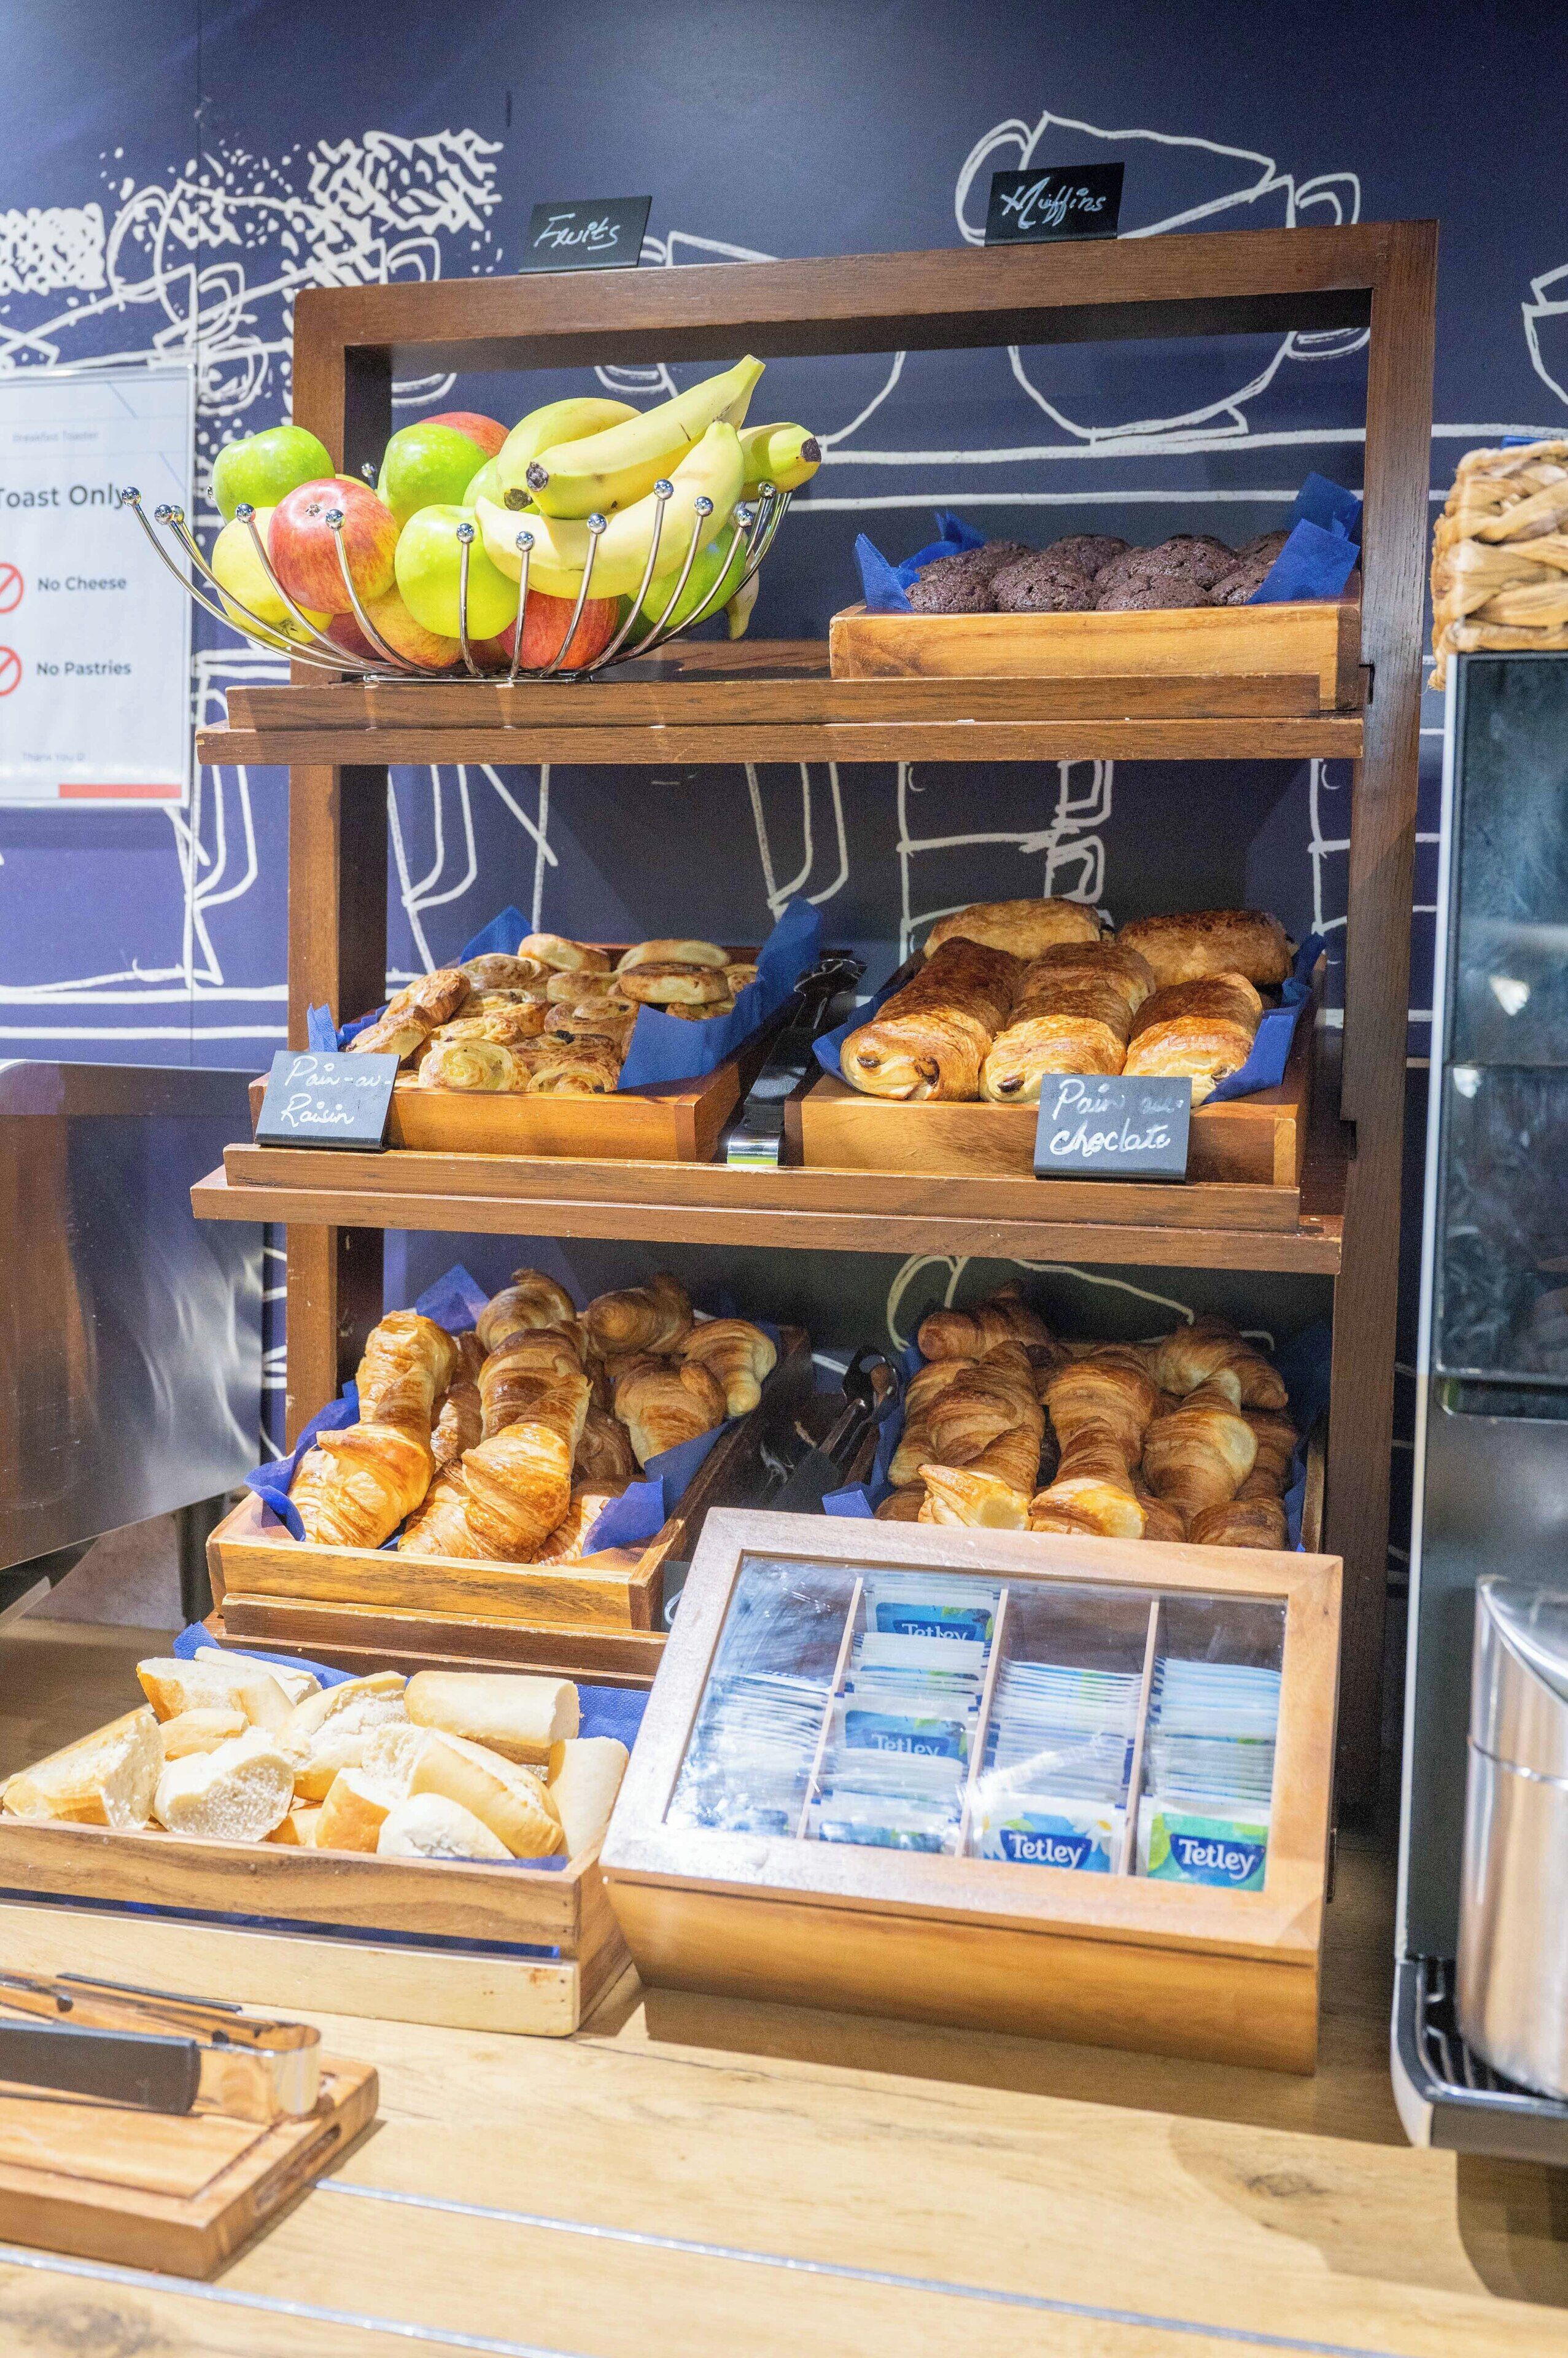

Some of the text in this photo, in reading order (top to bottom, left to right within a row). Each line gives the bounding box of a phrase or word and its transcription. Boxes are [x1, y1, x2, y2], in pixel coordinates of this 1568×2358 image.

[999, 176, 1107, 230] Muffins
[534, 213, 621, 251] Fruits
[69, 483, 123, 509] Only
[37, 575, 126, 591] No Cheese
[37, 660, 131, 675] No Pastries
[281, 1093, 354, 1127] Raisin
[1009, 1834, 1083, 1869] Tetley
[1178, 1838, 1256, 1880] Tetley
